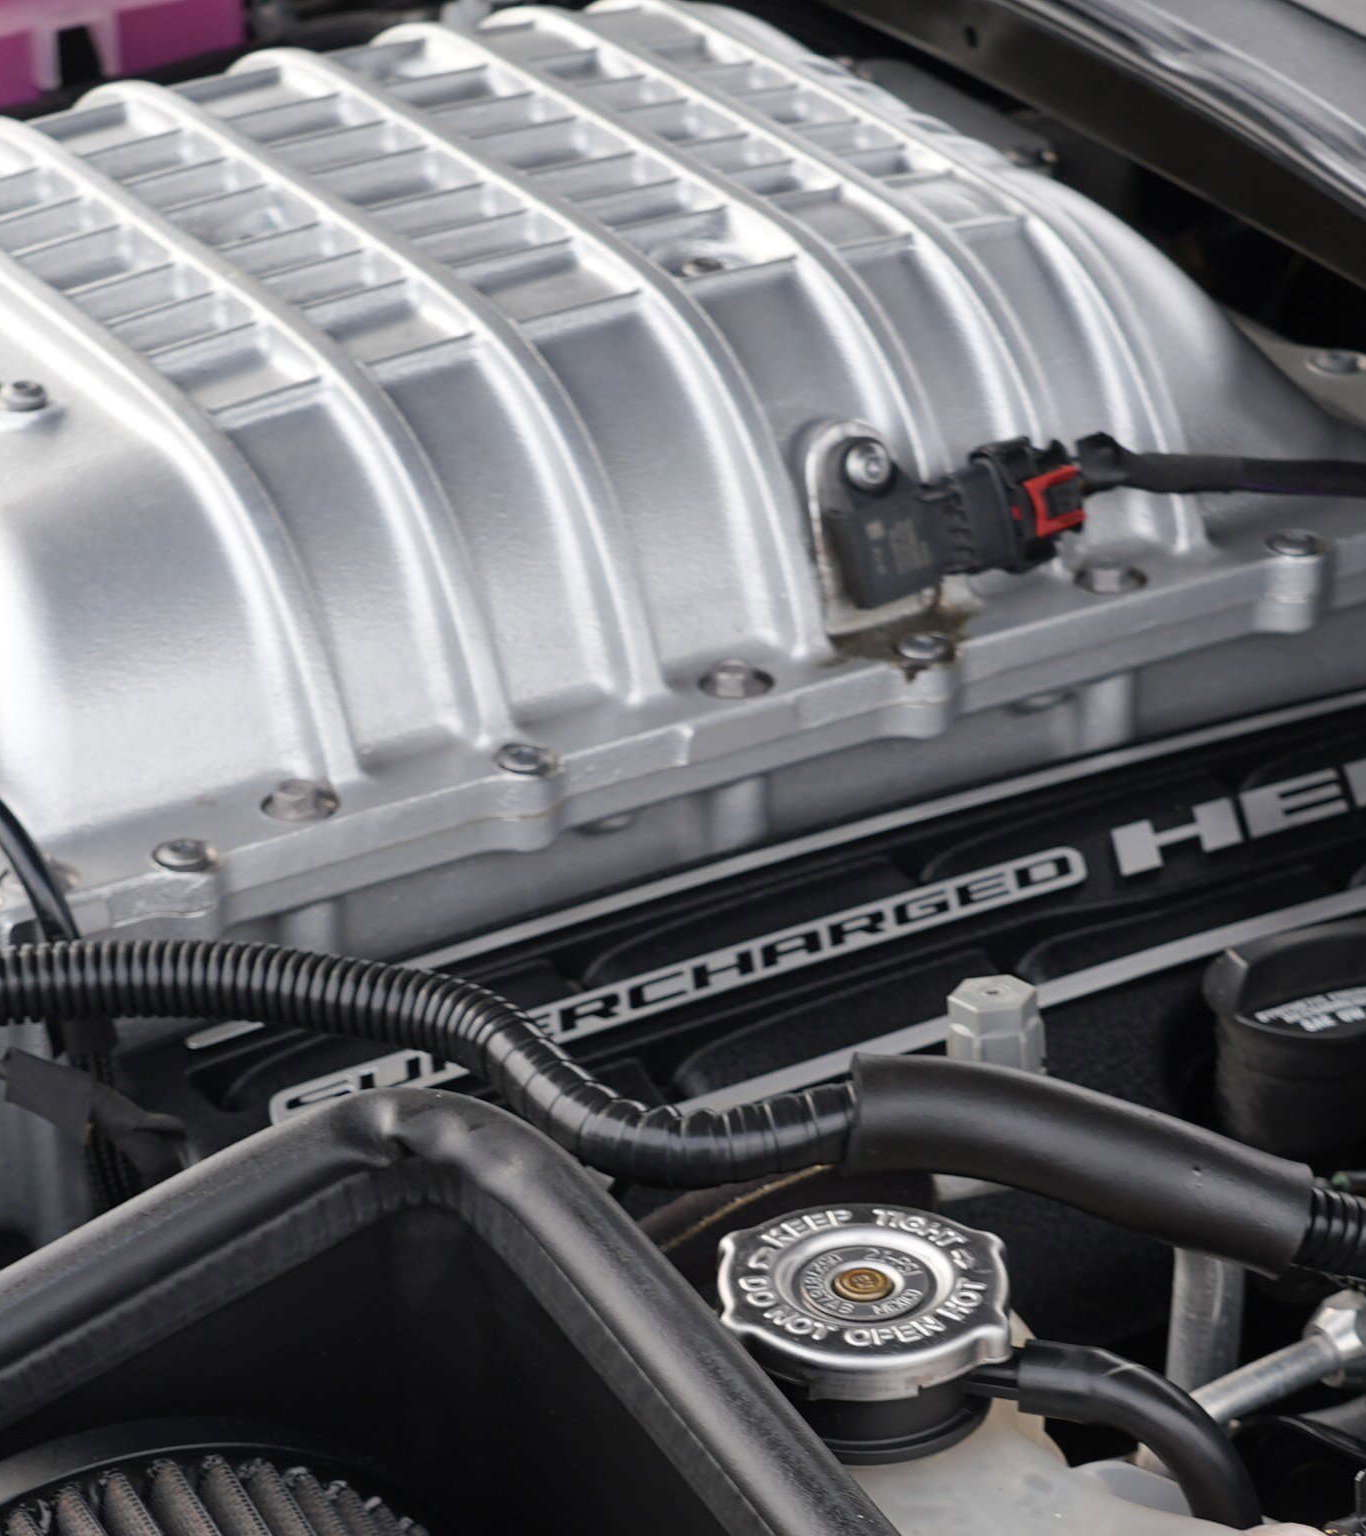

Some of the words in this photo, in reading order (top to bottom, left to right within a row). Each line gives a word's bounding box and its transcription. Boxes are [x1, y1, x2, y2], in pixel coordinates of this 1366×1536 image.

[283, 853, 1073, 1110] SURCHARGED
[760, 1209, 853, 1247] KEEP
[871, 1209, 969, 1247] TIGHT
[738, 1276, 777, 1307] DO
[763, 1308, 839, 1341] NOT
[844, 1314, 947, 1346] OPEN
[936, 1276, 988, 1322] HOT
